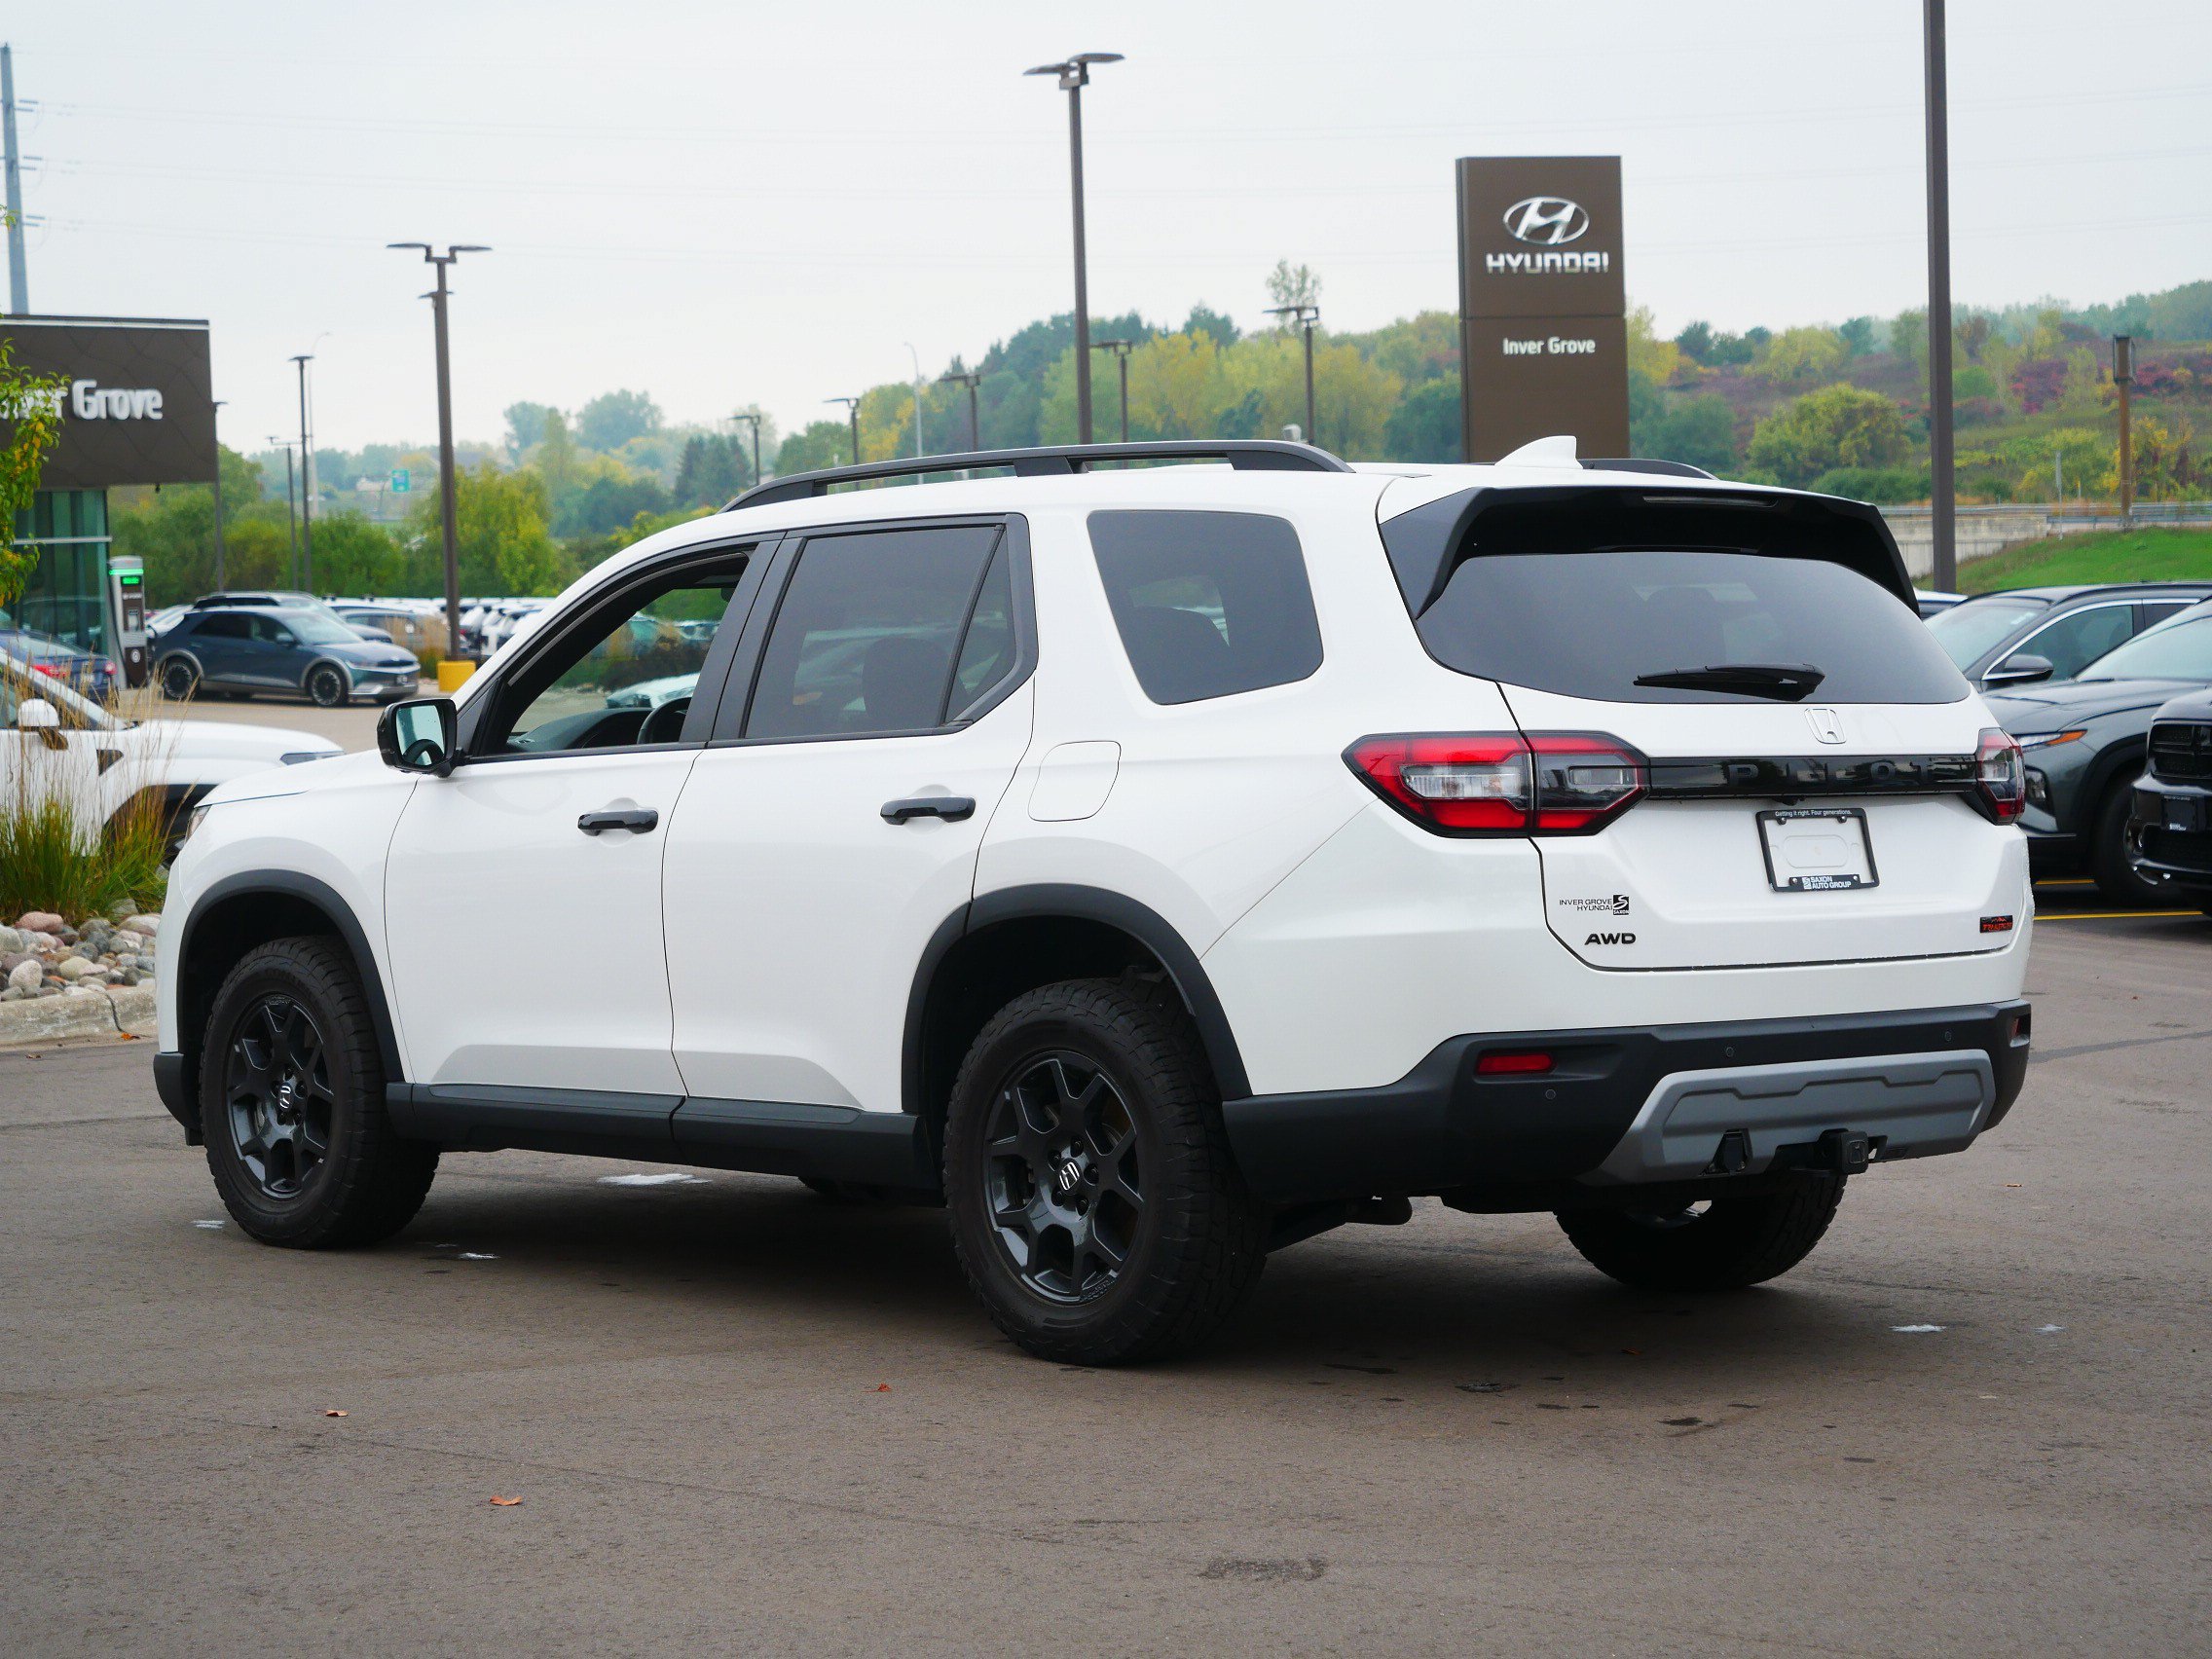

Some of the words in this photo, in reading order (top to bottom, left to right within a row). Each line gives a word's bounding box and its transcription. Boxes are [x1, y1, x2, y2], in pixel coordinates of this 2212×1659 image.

[1486, 252, 1609, 274] HYUNDAI
[1503, 337, 1545, 355] Inver
[1547, 336, 1596, 354] Grove
[71, 378, 164, 421] Grove
[1829, 880, 1852, 889] GROUP
[1584, 932, 1637, 945] AWD
